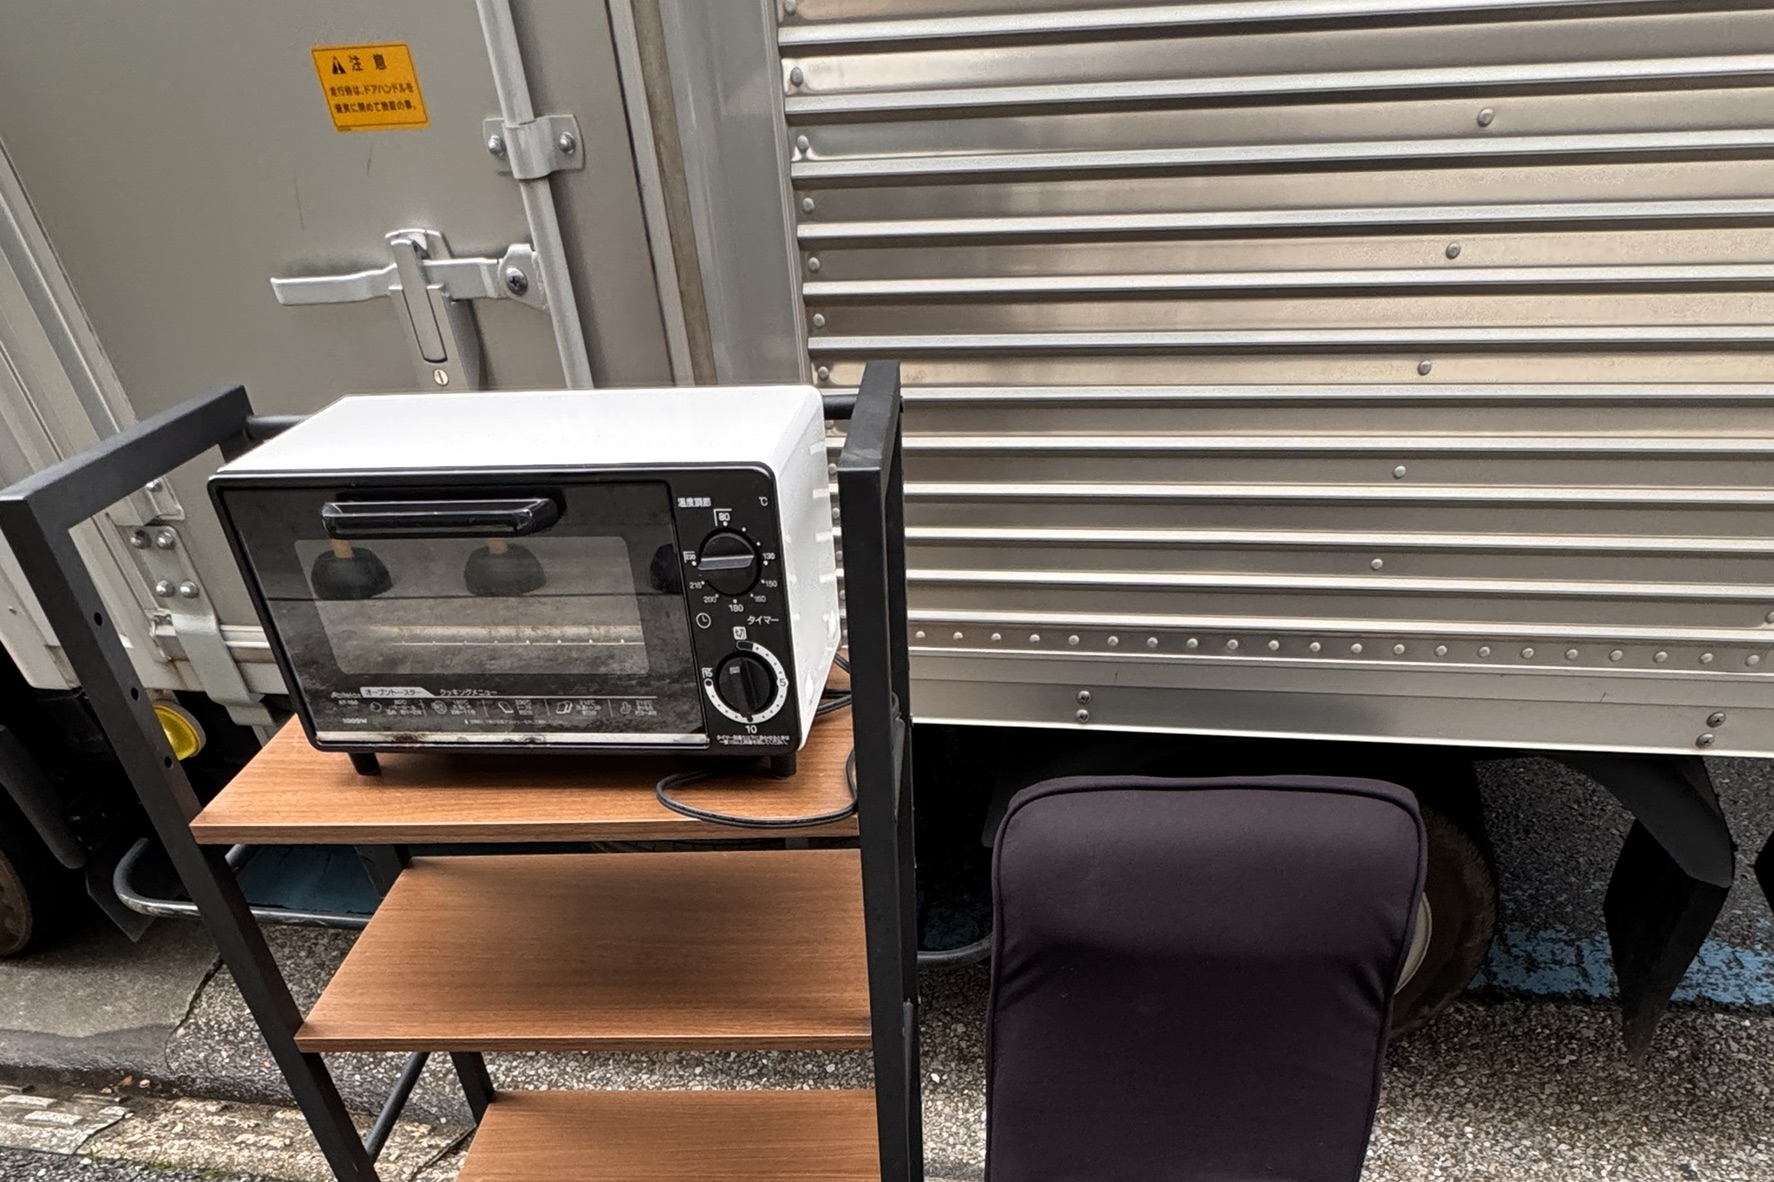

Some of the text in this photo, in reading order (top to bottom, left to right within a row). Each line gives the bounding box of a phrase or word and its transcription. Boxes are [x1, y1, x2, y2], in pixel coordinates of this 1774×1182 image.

[348, 54, 387, 71] 注意
[718, 512, 731, 521] 80
[762, 552, 776, 560] 130
[703, 596, 718, 604] 200
[728, 604, 744, 613] 180
[746, 615, 780, 625] タイマー
[734, 628, 745, 638] 切
[779, 677, 787, 688] 5
[745, 725, 758, 734] 10
